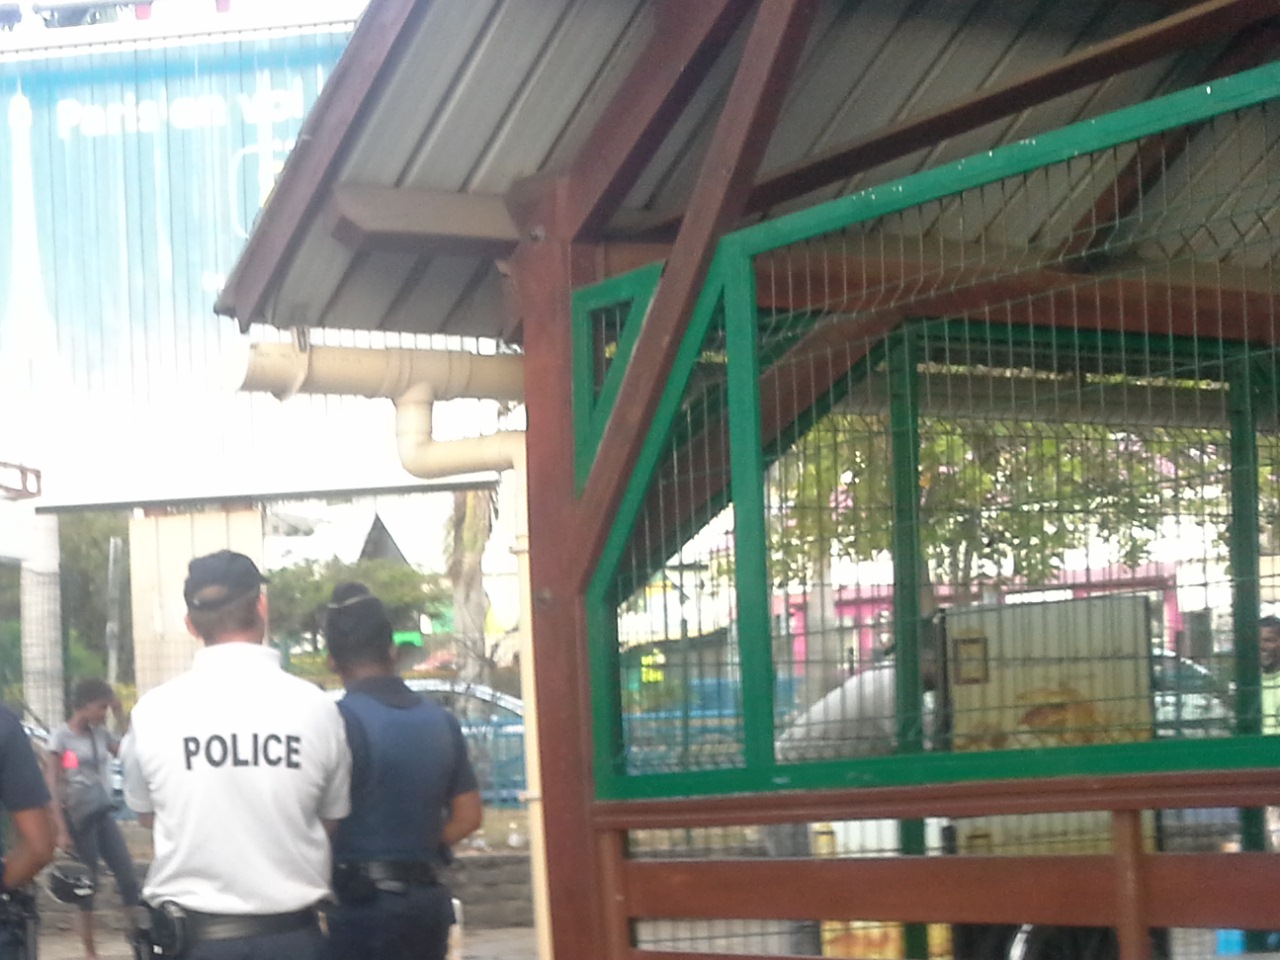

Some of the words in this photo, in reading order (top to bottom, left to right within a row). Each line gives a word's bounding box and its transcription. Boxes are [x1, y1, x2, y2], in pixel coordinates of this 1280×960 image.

[56, 91, 161, 139] Paris
[169, 94, 226, 130] en
[183, 733, 302, 771] POLICE
